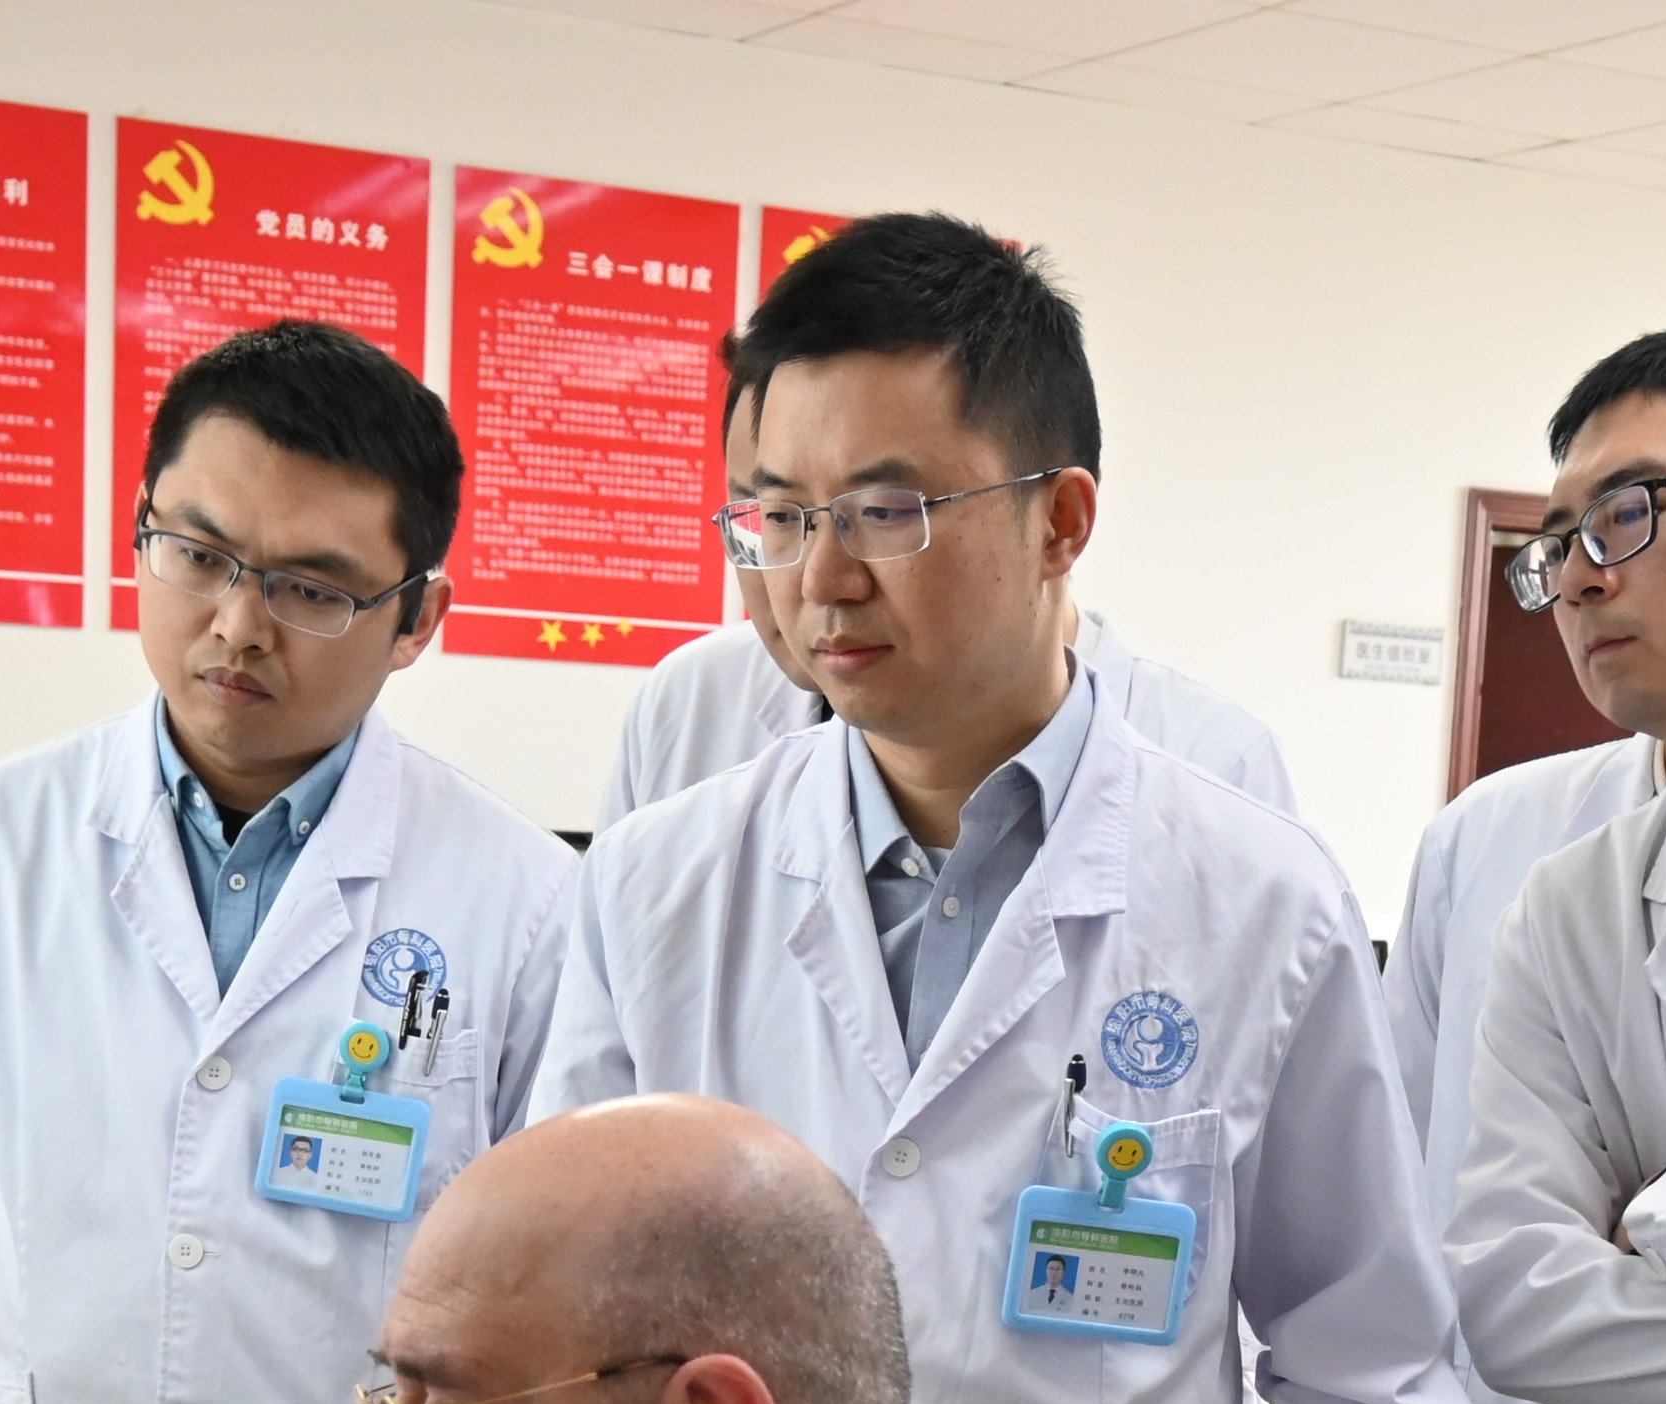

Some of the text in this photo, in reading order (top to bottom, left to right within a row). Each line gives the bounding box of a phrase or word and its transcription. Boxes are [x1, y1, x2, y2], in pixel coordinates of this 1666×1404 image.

[255, 208, 389, 252] 党员的义务
[566, 251, 713, 293] 三会一课制度
